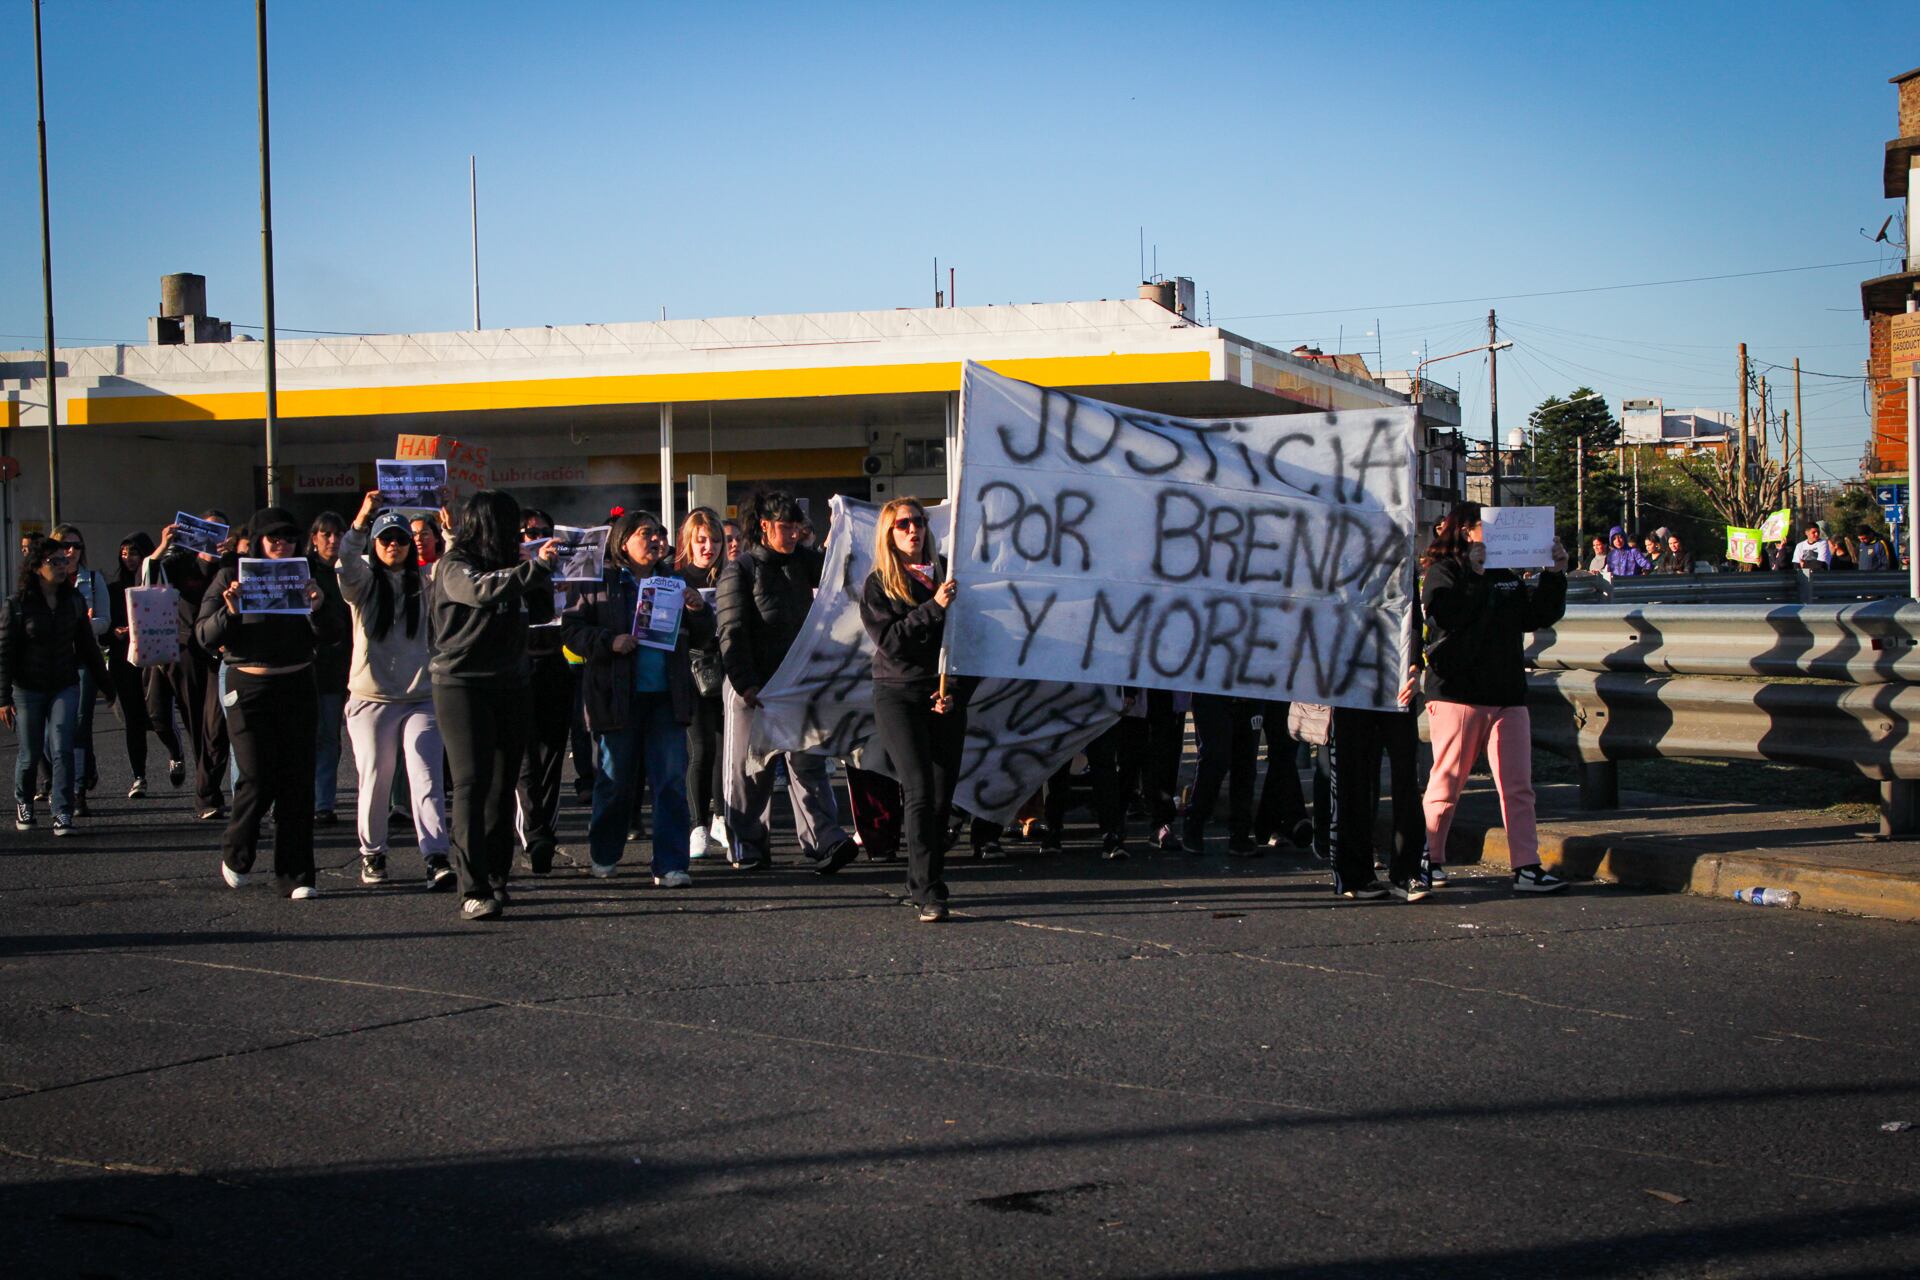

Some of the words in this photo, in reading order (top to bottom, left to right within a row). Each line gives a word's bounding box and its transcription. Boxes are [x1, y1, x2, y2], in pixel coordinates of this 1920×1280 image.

[299, 473, 354, 487] Lavado
[383, 515, 399, 524] NY
[977, 481, 1096, 572] POR
[1152, 487, 1410, 598] BRENDA
[1007, 582, 1057, 667] Y
[1080, 582, 1390, 707] MORENA
